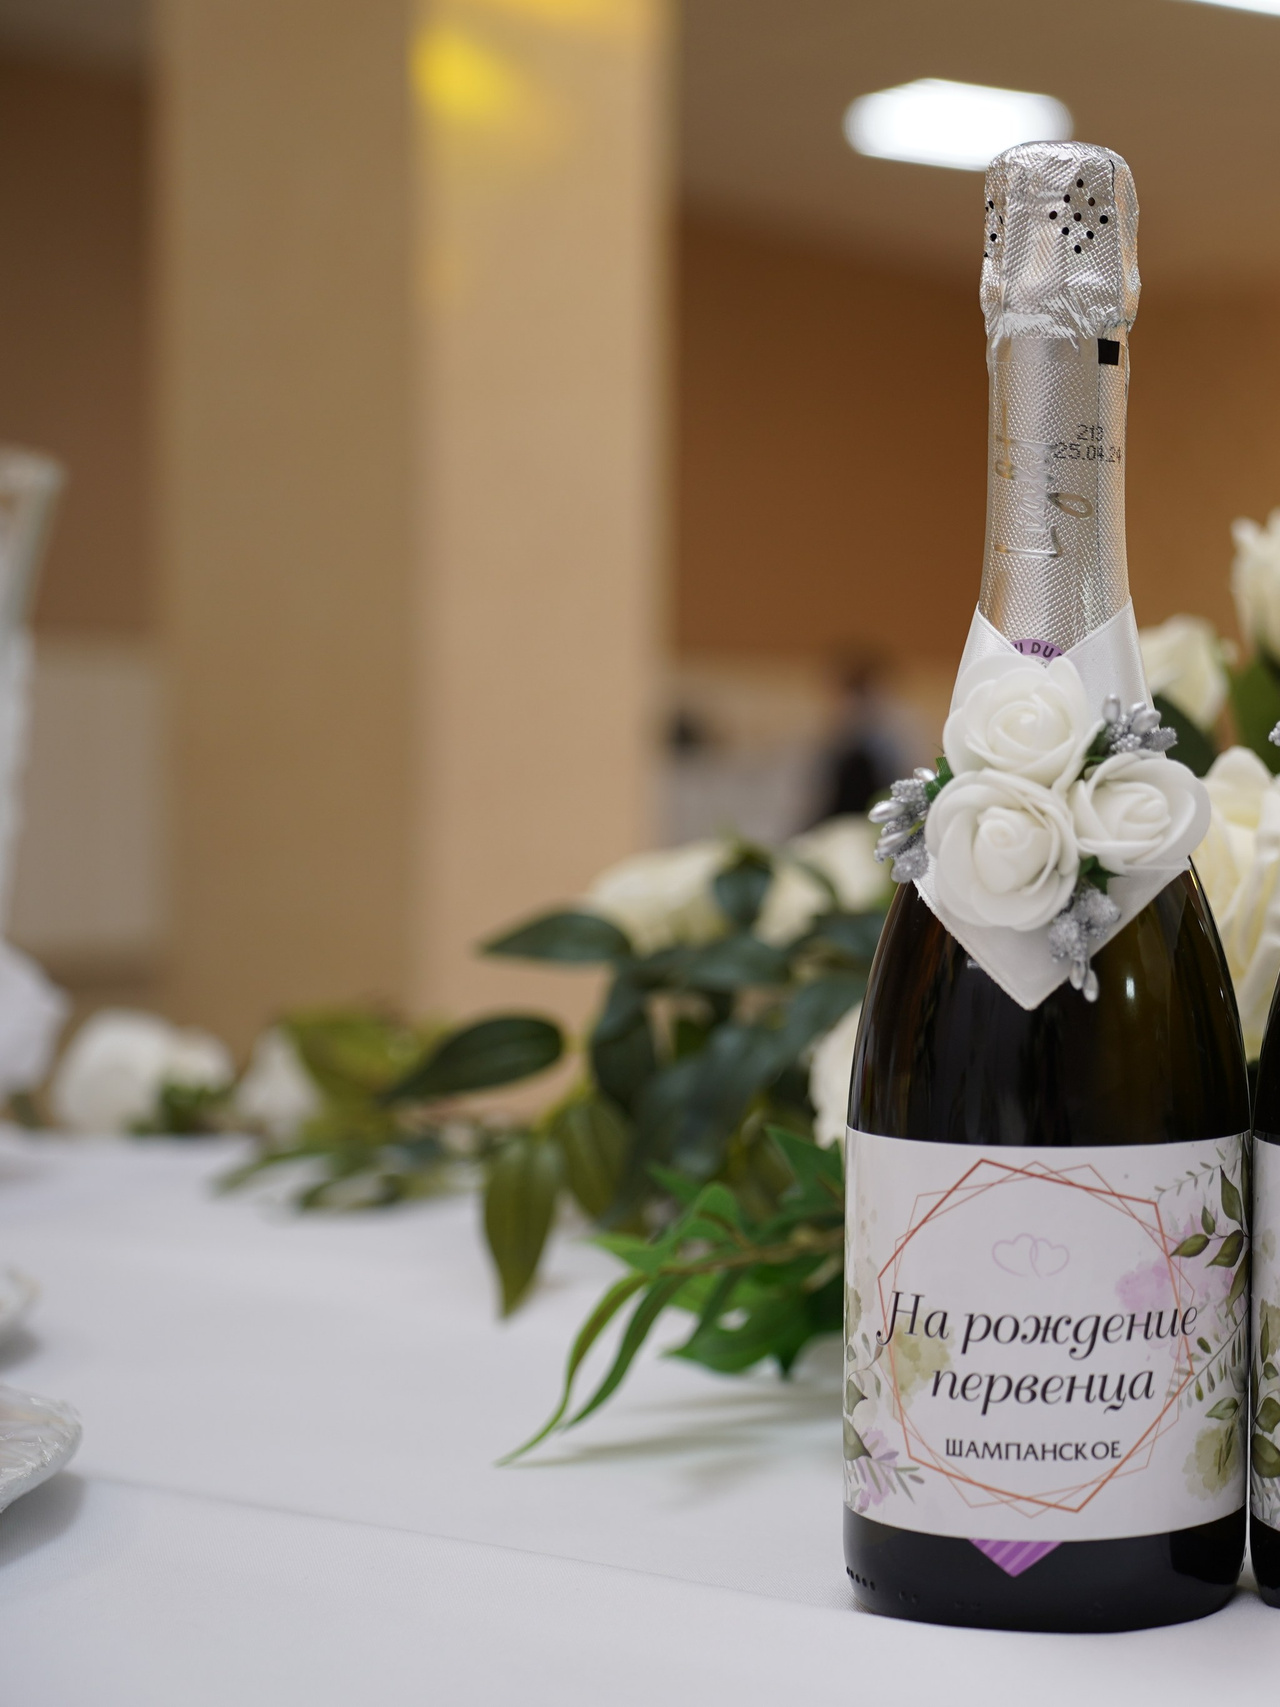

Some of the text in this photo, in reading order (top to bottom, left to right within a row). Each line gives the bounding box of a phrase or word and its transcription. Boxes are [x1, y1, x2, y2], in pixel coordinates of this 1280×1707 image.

[876, 1290, 1199, 1360] На рождение
[931, 1368, 1155, 1416] первенца
[945, 1438, 1122, 1461] ШАМПАНСКОЕ
